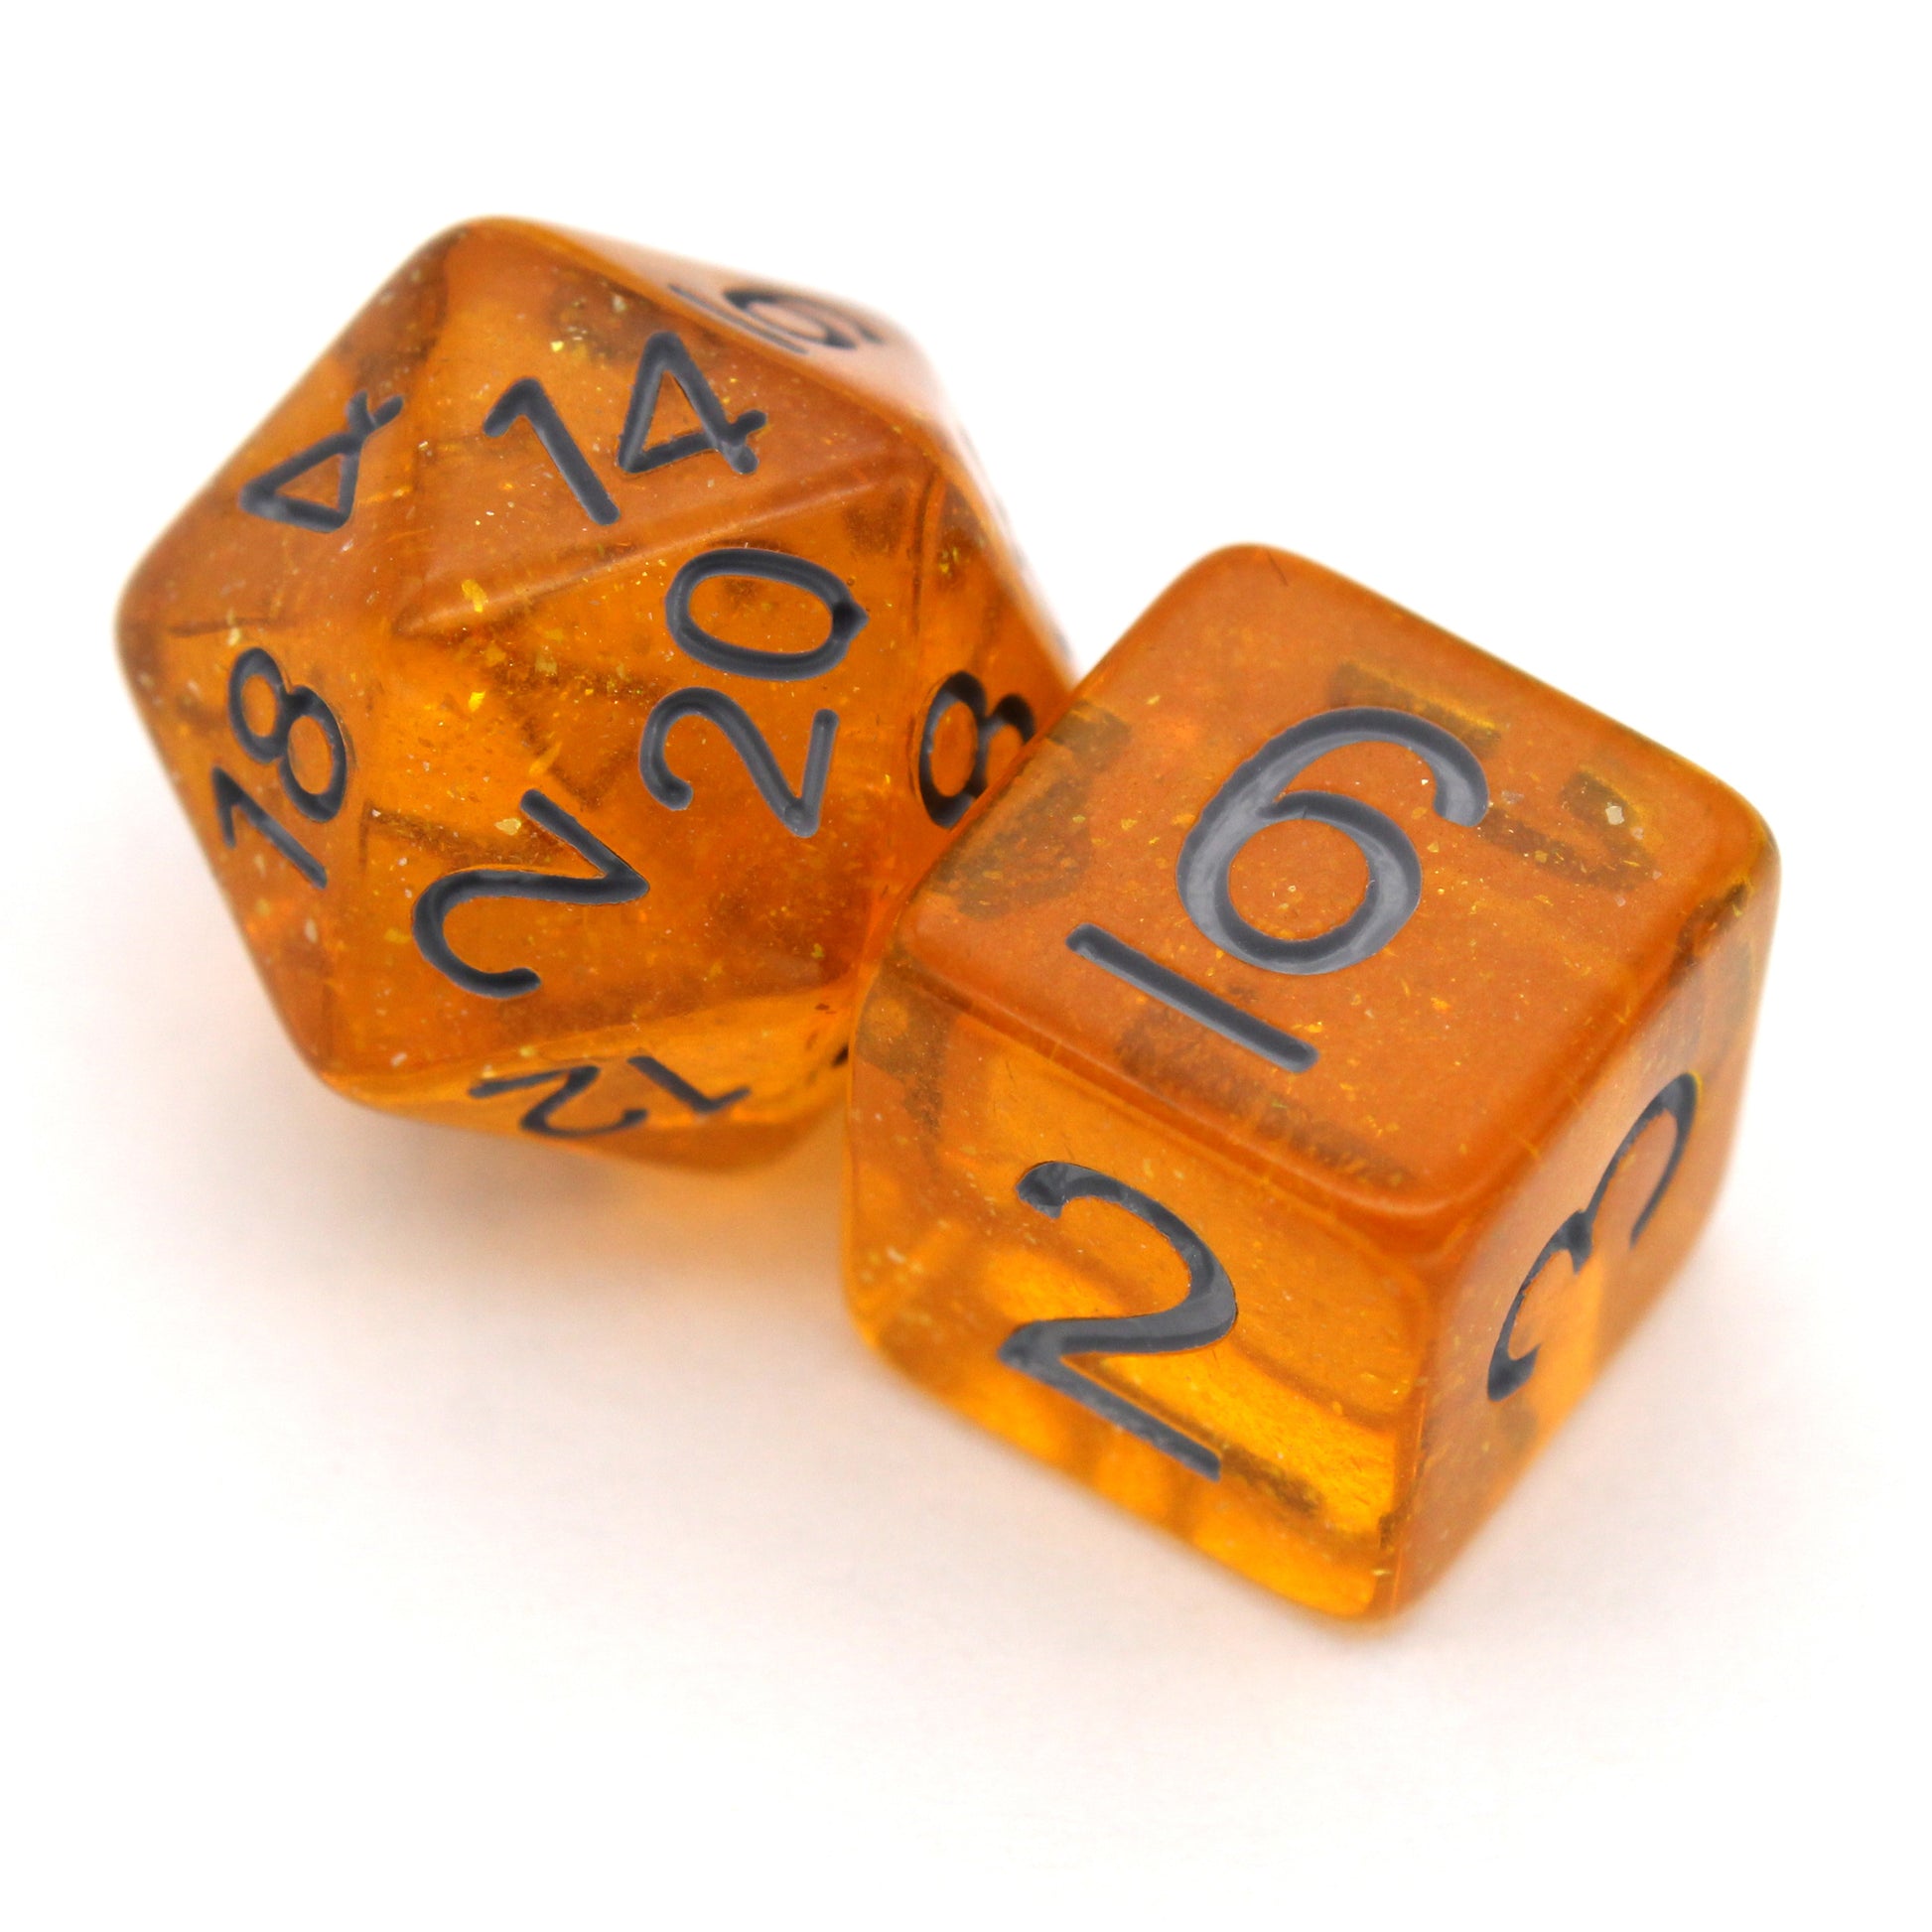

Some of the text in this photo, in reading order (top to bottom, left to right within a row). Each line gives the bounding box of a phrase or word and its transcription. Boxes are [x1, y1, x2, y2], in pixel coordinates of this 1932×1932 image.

[239, 391, 404, 533] 4
[484, 332, 767, 525] 14
[211, 647, 348, 889] 18
[640, 548, 870, 837] 20
[413, 789, 649, 998] 2
[1066, 707, 1489, 1072] 6
[469, 1055, 752, 1138] 12
[1000, 1161, 1238, 1480] 2
[1487, 1073, 1701, 1403] 3
